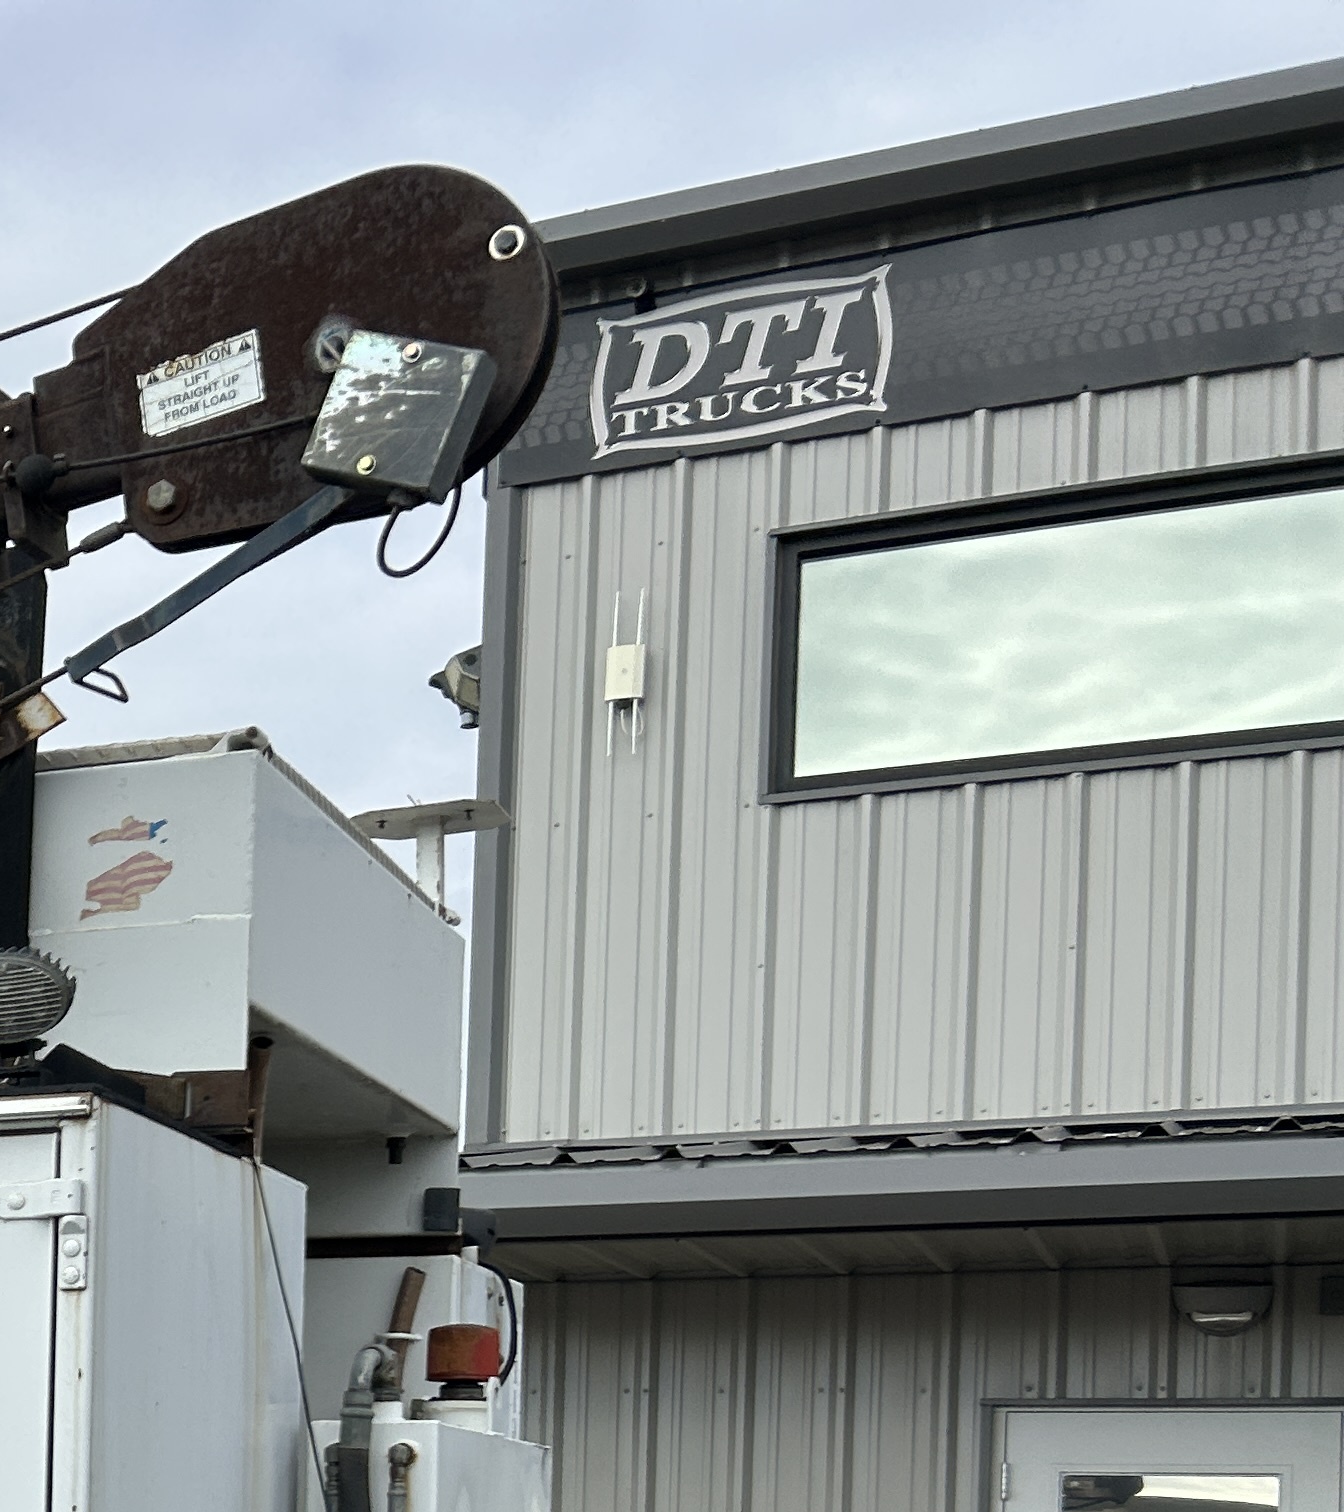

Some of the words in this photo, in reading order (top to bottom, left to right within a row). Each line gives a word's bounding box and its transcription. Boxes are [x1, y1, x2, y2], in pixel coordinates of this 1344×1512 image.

[163, 342, 232, 378] CAUTION
[614, 288, 865, 407] DTI
[157, 381, 219, 411] STRAIGHT
[222, 373, 241, 388] UP
[183, 369, 211, 388] LIFT
[164, 402, 200, 423] FROM
[202, 389, 237, 409] LOAD
[610, 369, 868, 438] TRUCKS
